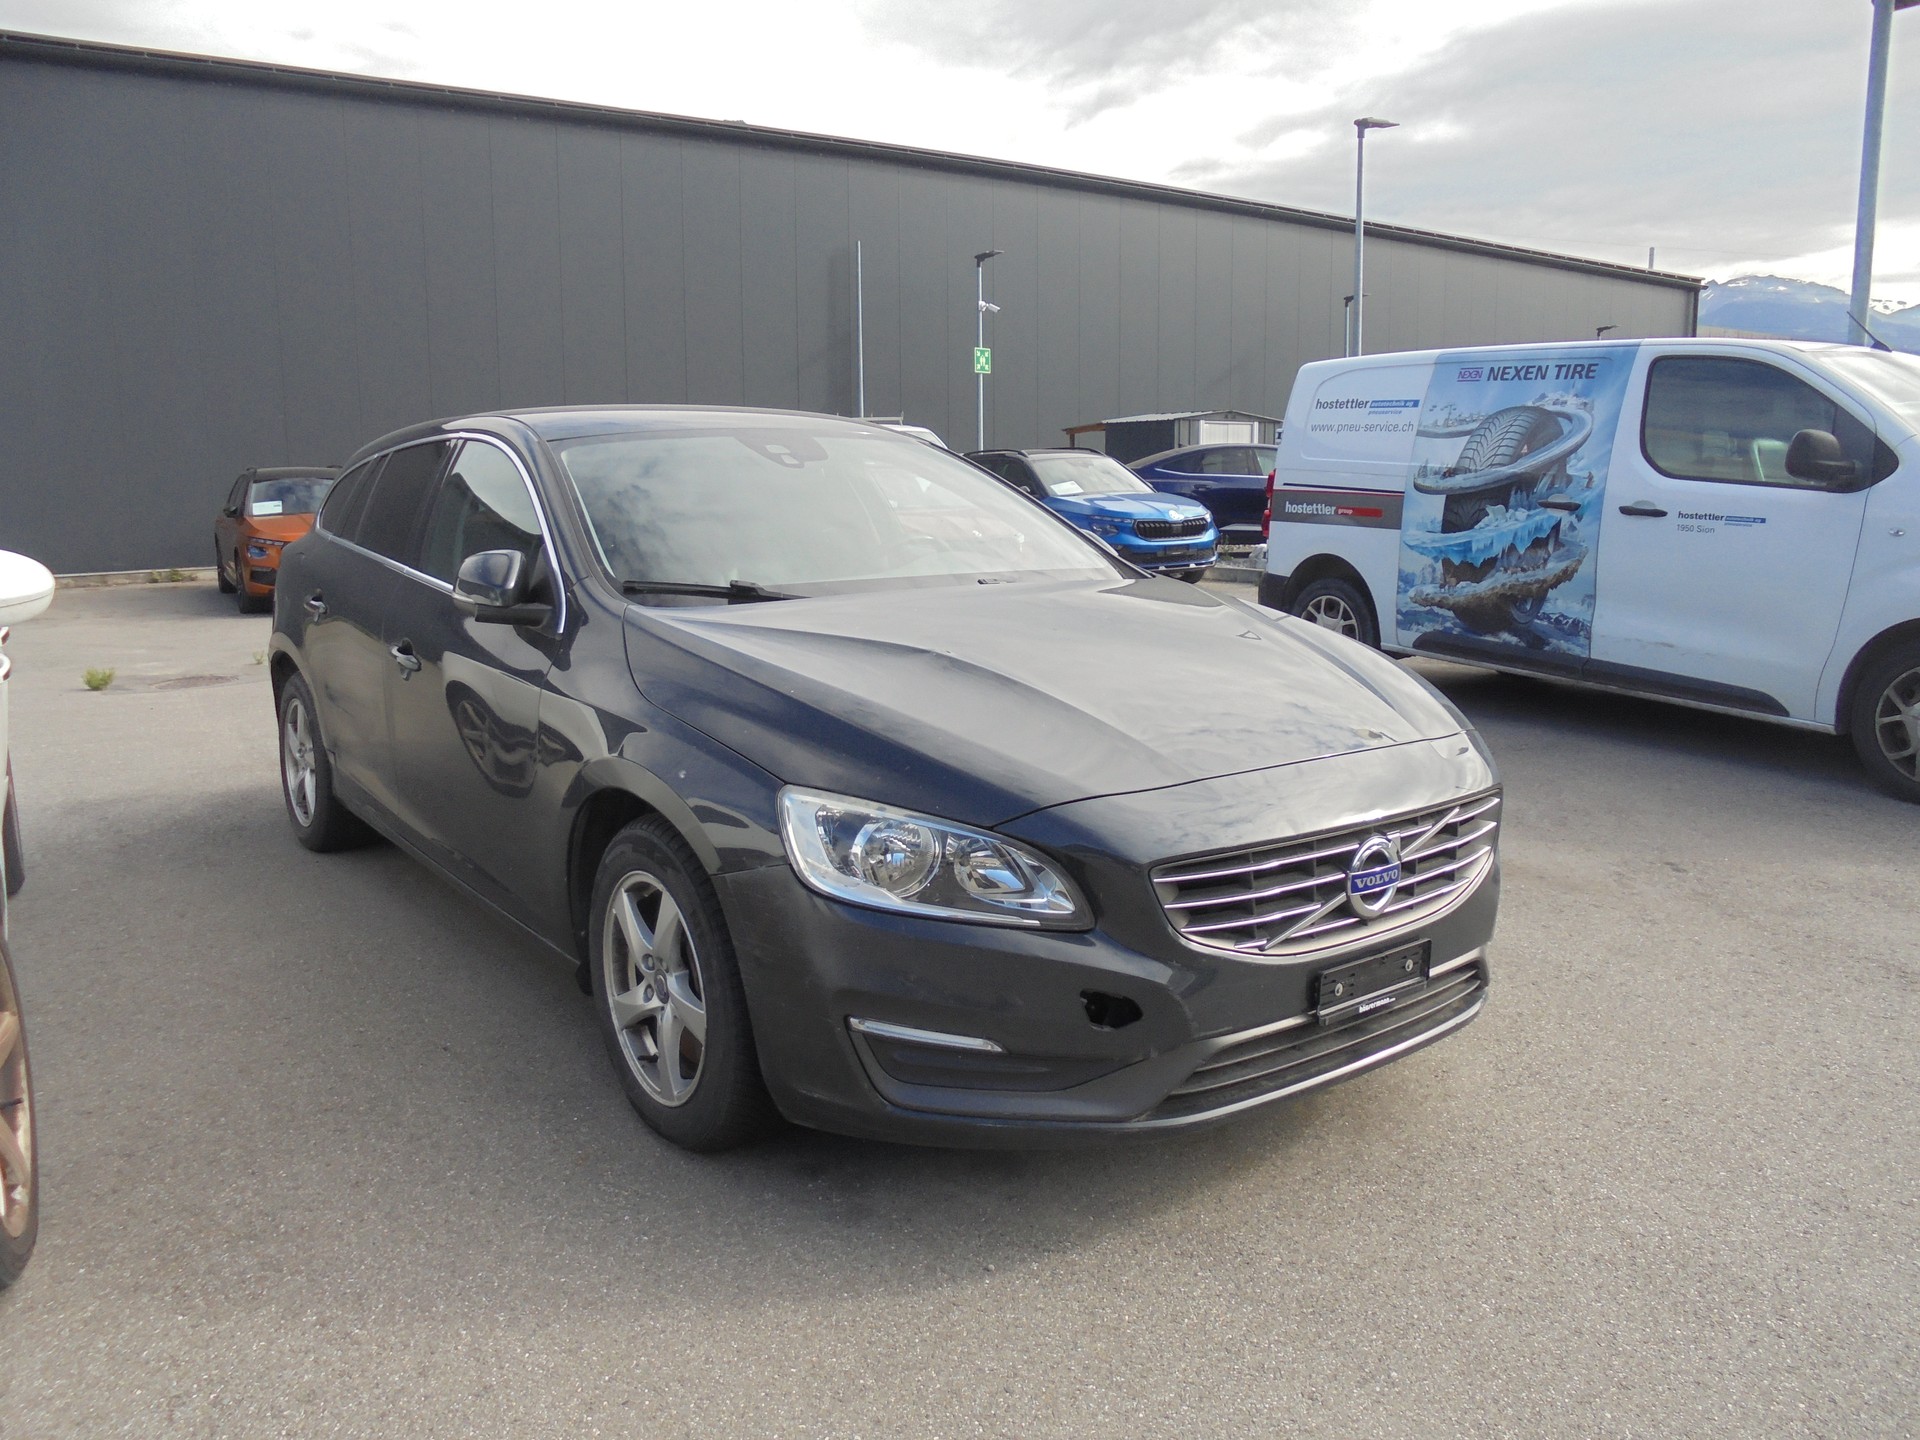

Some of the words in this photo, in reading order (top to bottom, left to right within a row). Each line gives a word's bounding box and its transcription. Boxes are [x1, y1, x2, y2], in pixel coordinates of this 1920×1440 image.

[1487, 365, 1549, 381] NEXEN
[1555, 363, 1599, 380] TIRE
[1315, 399, 1370, 409] hostettler
[1311, 421, 1414, 434] www.pneu-service.ch
[1285, 501, 1336, 515] hostettler
[1678, 510, 1725, 521] hostettler
[1677, 524, 1695, 533] 1950
[1696, 525, 1715, 534] Sion
[1354, 869, 1399, 889] VOLVO
